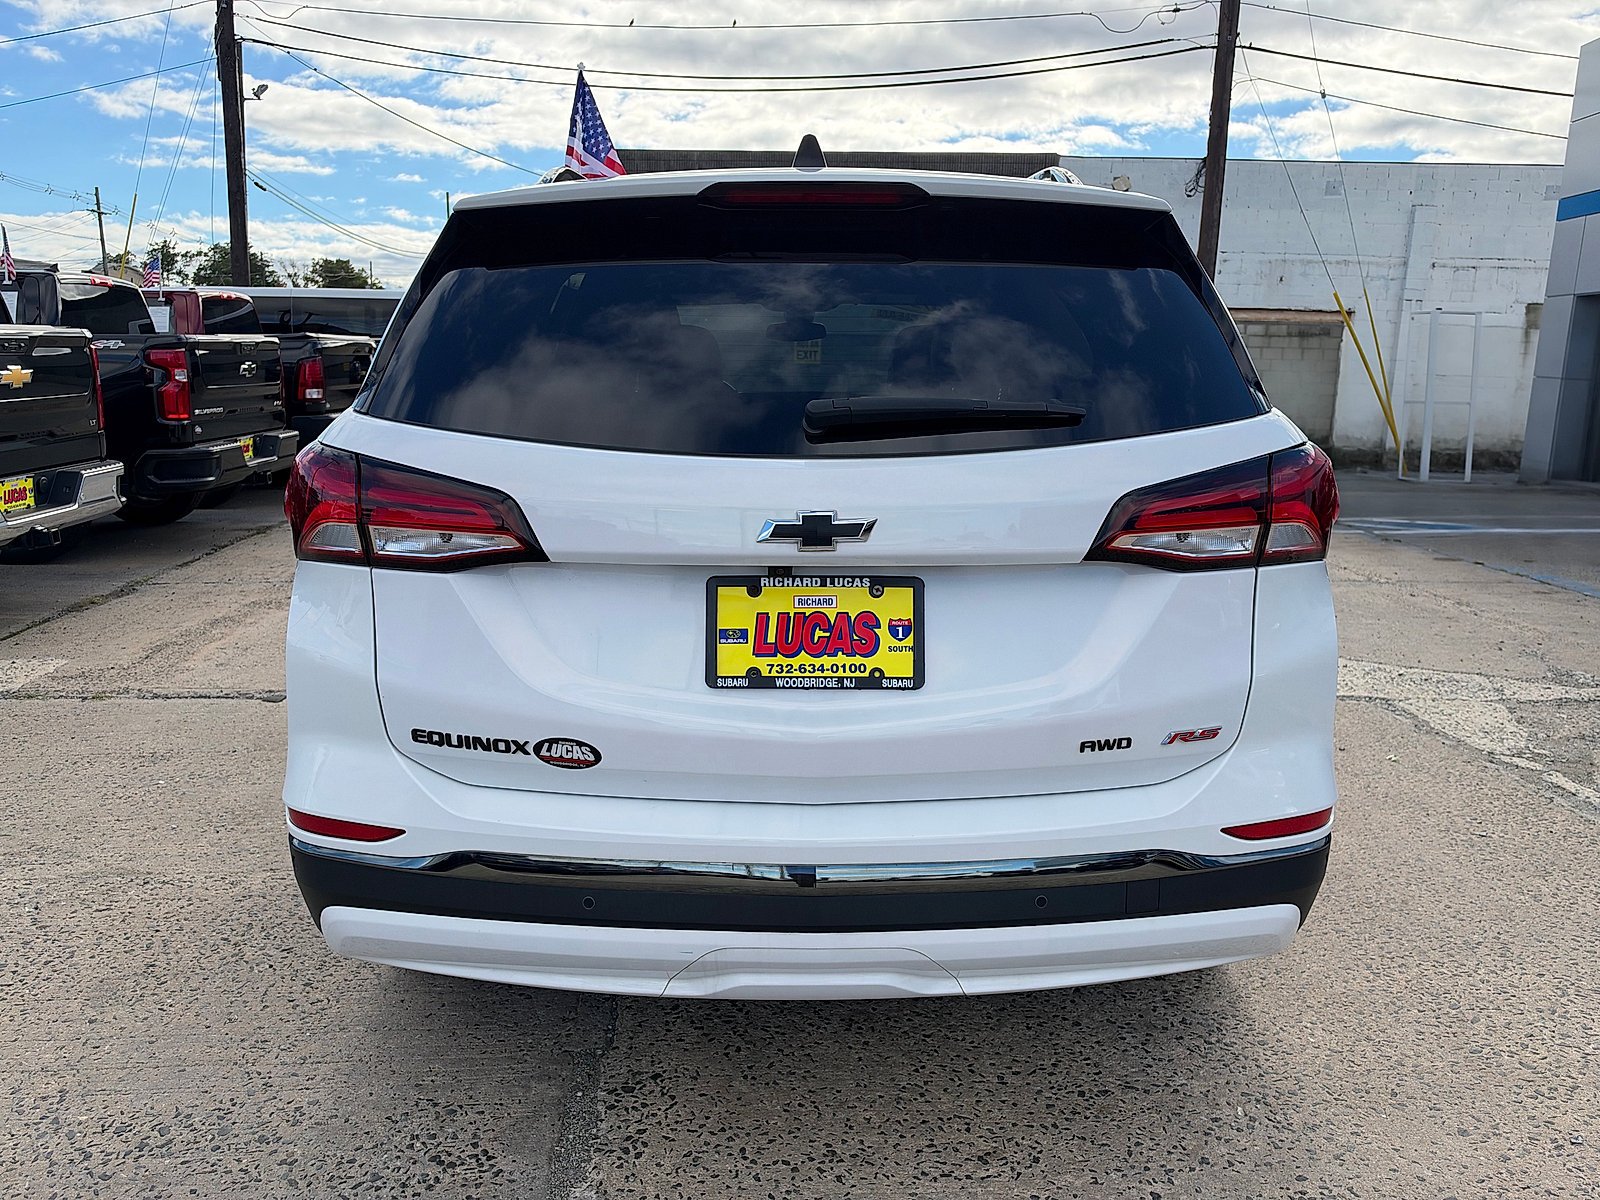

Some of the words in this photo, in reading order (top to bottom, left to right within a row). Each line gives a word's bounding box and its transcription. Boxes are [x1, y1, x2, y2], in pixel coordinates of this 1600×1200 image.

[797, 351, 818, 361] EXIT
[4, 486, 27, 505] LUCAS
[760, 577, 821, 588] RICHARD
[826, 577, 871, 588] LUCAS
[797, 597, 834, 607] RICHARD
[752, 611, 881, 658] LUCAS
[896, 626, 905, 639] 1
[766, 663, 867, 675] 732-634-0100
[717, 678, 749, 687] SUBARU
[775, 678, 842, 688] WOODBRIDGE,
[844, 678, 856, 688] NJ
[882, 679, 914, 688] SUBARU
[1163, 726, 1222, 745] RS
[411, 728, 531, 756] EQUINOX
[1079, 737, 1132, 753] AWD
[540, 742, 595, 761] LUCAS
